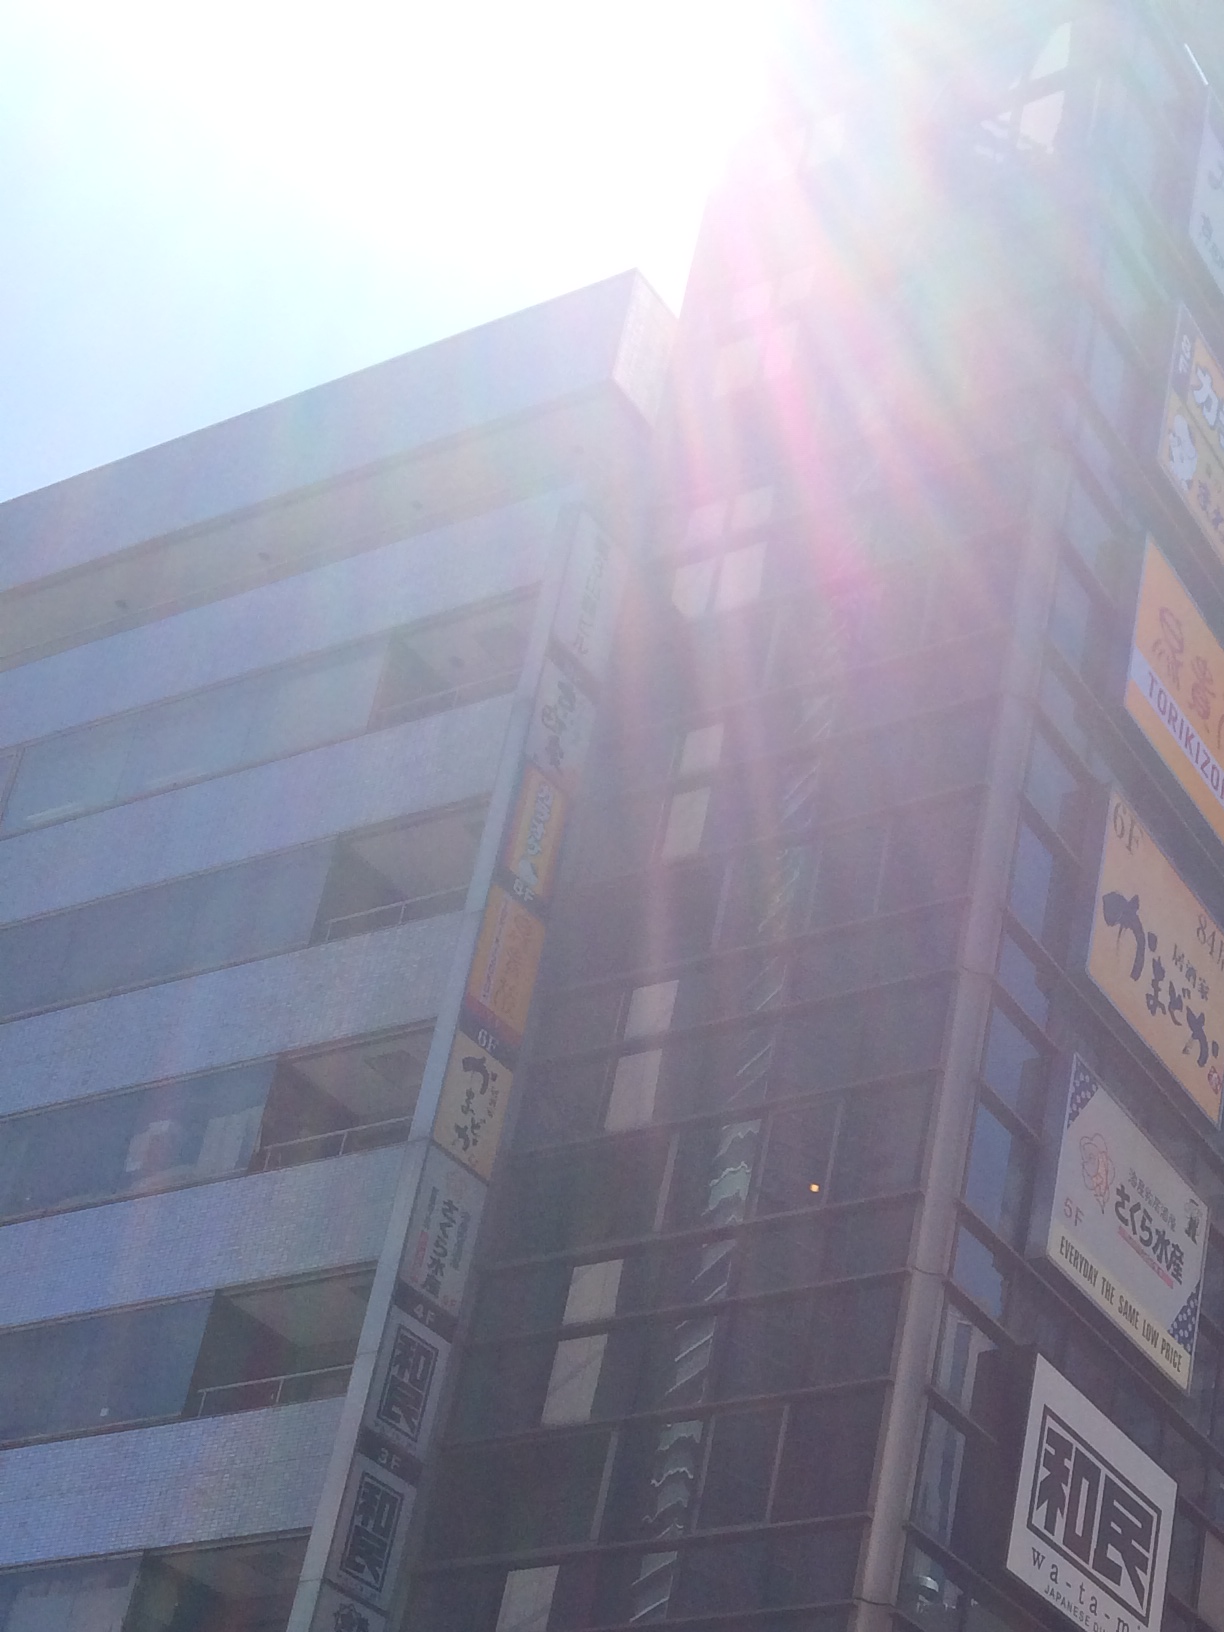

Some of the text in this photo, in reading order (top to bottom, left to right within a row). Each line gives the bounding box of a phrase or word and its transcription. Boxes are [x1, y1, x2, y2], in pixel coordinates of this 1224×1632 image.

[1179, 333, 1192, 375] 8F
[1112, 801, 1142, 858] 6F
[1101, 890, 1219, 1067] かまどか
[421, 1198, 460, 1299] さくら水産
[1064, 1196, 1083, 1228] 5F
[1114, 1183, 1184, 1286] さくら水産
[412, 1301, 437, 1330] 4F
[1058, 1234, 1098, 1290] EVERYDAY
[1100, 1275, 1115, 1307] THE
[1117, 1292, 1140, 1332] SAME
[1141, 1316, 1159, 1351] LOW
[1160, 1335, 1182, 1373] PRICE
[391, 1332, 434, 1434] 和民
[376, 1445, 402, 1473] 3F
[346, 1480, 398, 1587] 和民
[1040, 1428, 1152, 1611] 和民
[1044, 1583, 1091, 1629] JAPANESE
